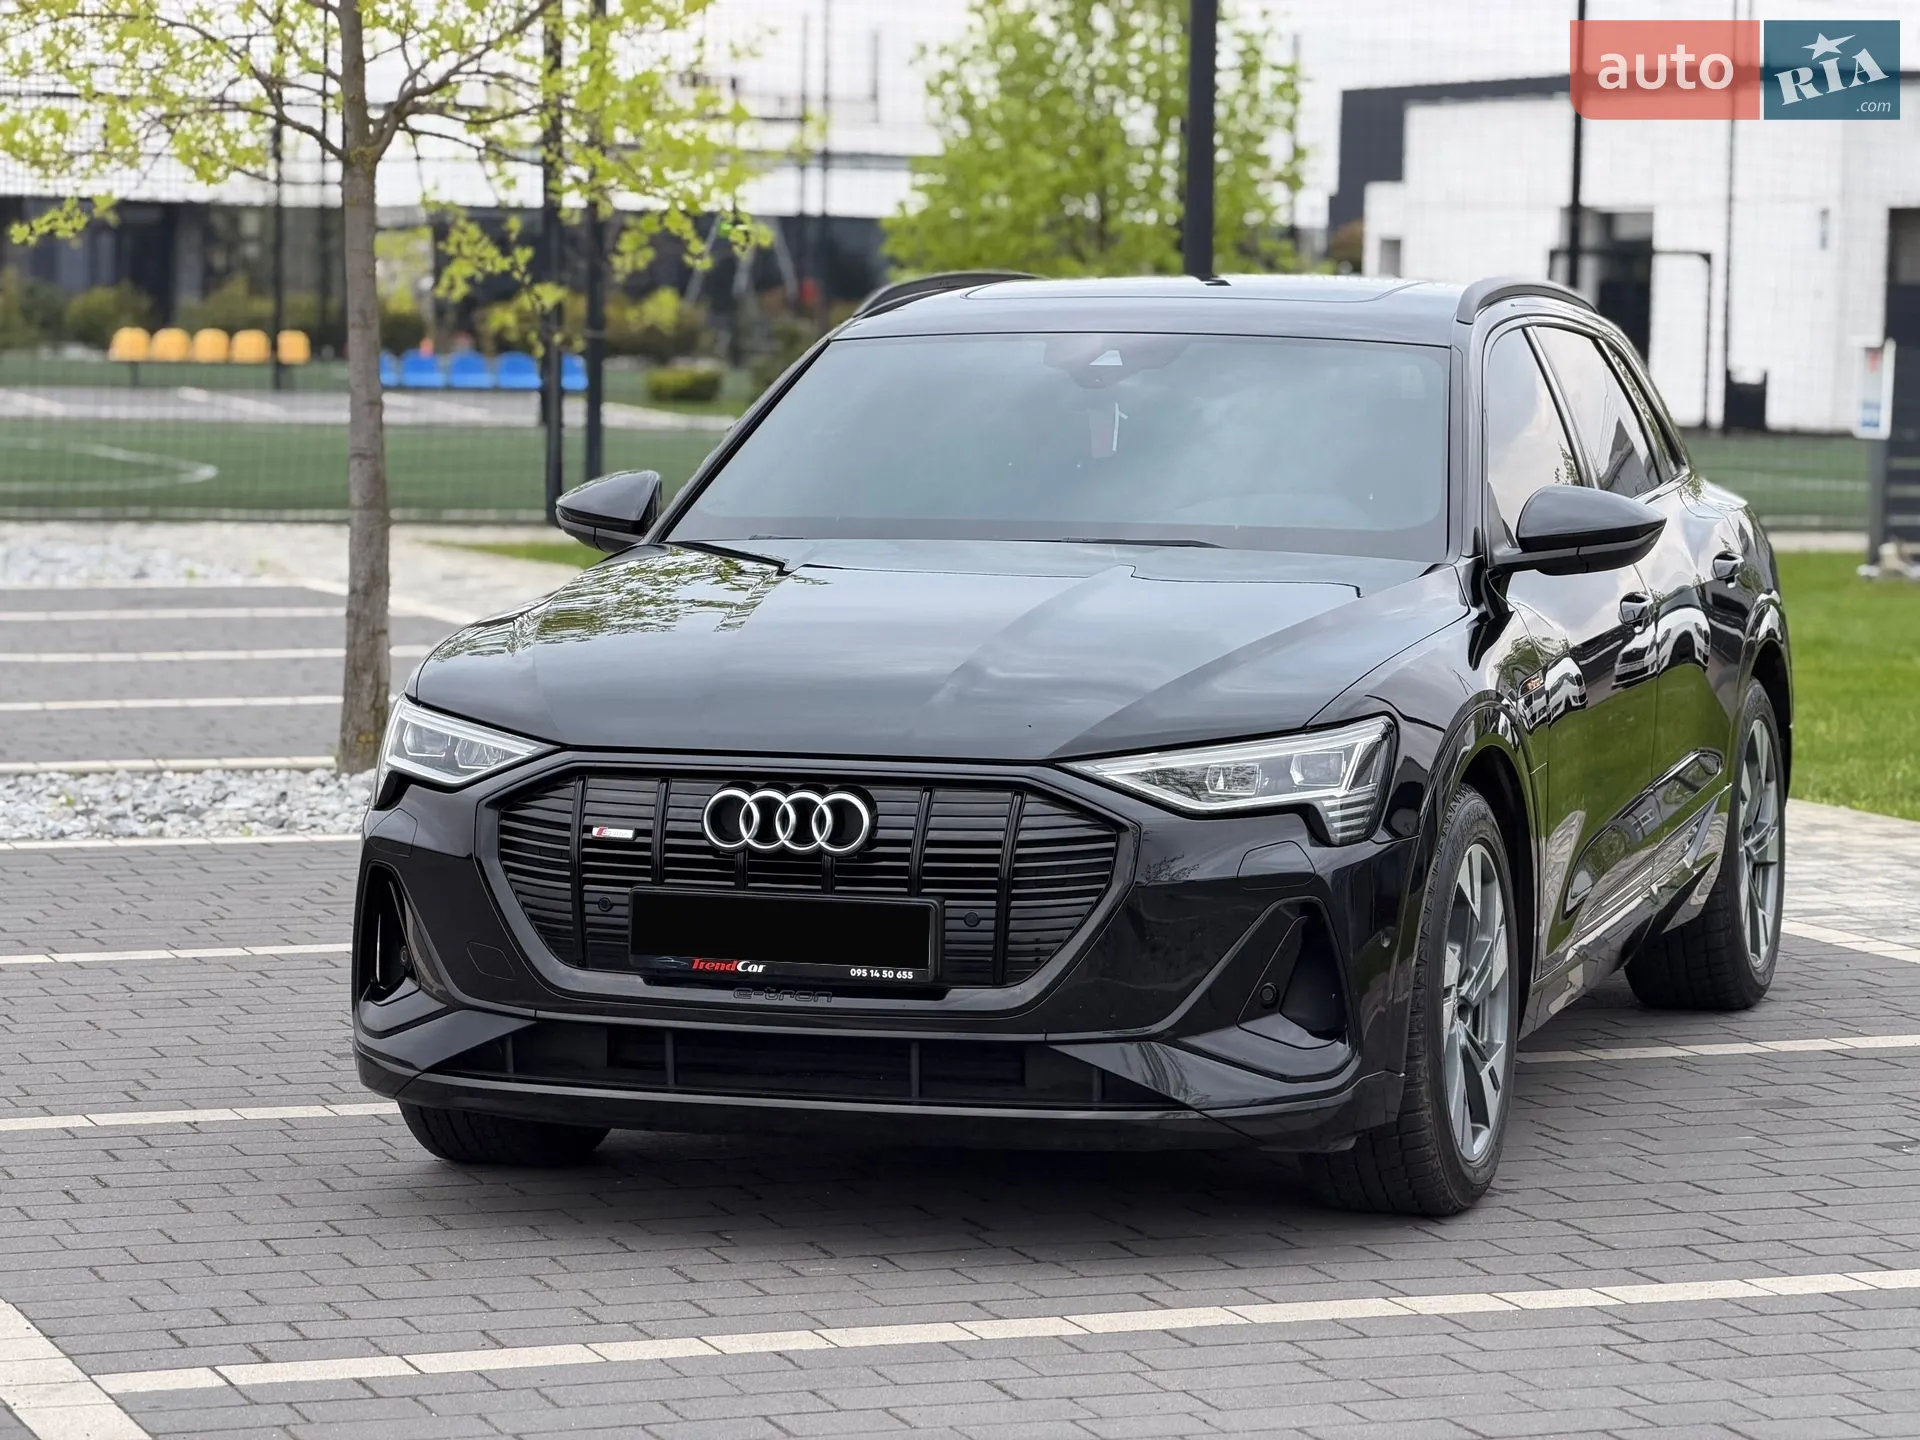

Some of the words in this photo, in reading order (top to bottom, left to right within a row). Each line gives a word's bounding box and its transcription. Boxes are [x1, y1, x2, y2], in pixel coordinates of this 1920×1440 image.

[692, 957, 767, 974] TrendCar
[850, 968, 867, 977] 095
[869, 968, 880, 978] 14
[882, 969, 894, 979] 50
[896, 970, 913, 980] 655
[733, 986, 833, 1004] e-tron
